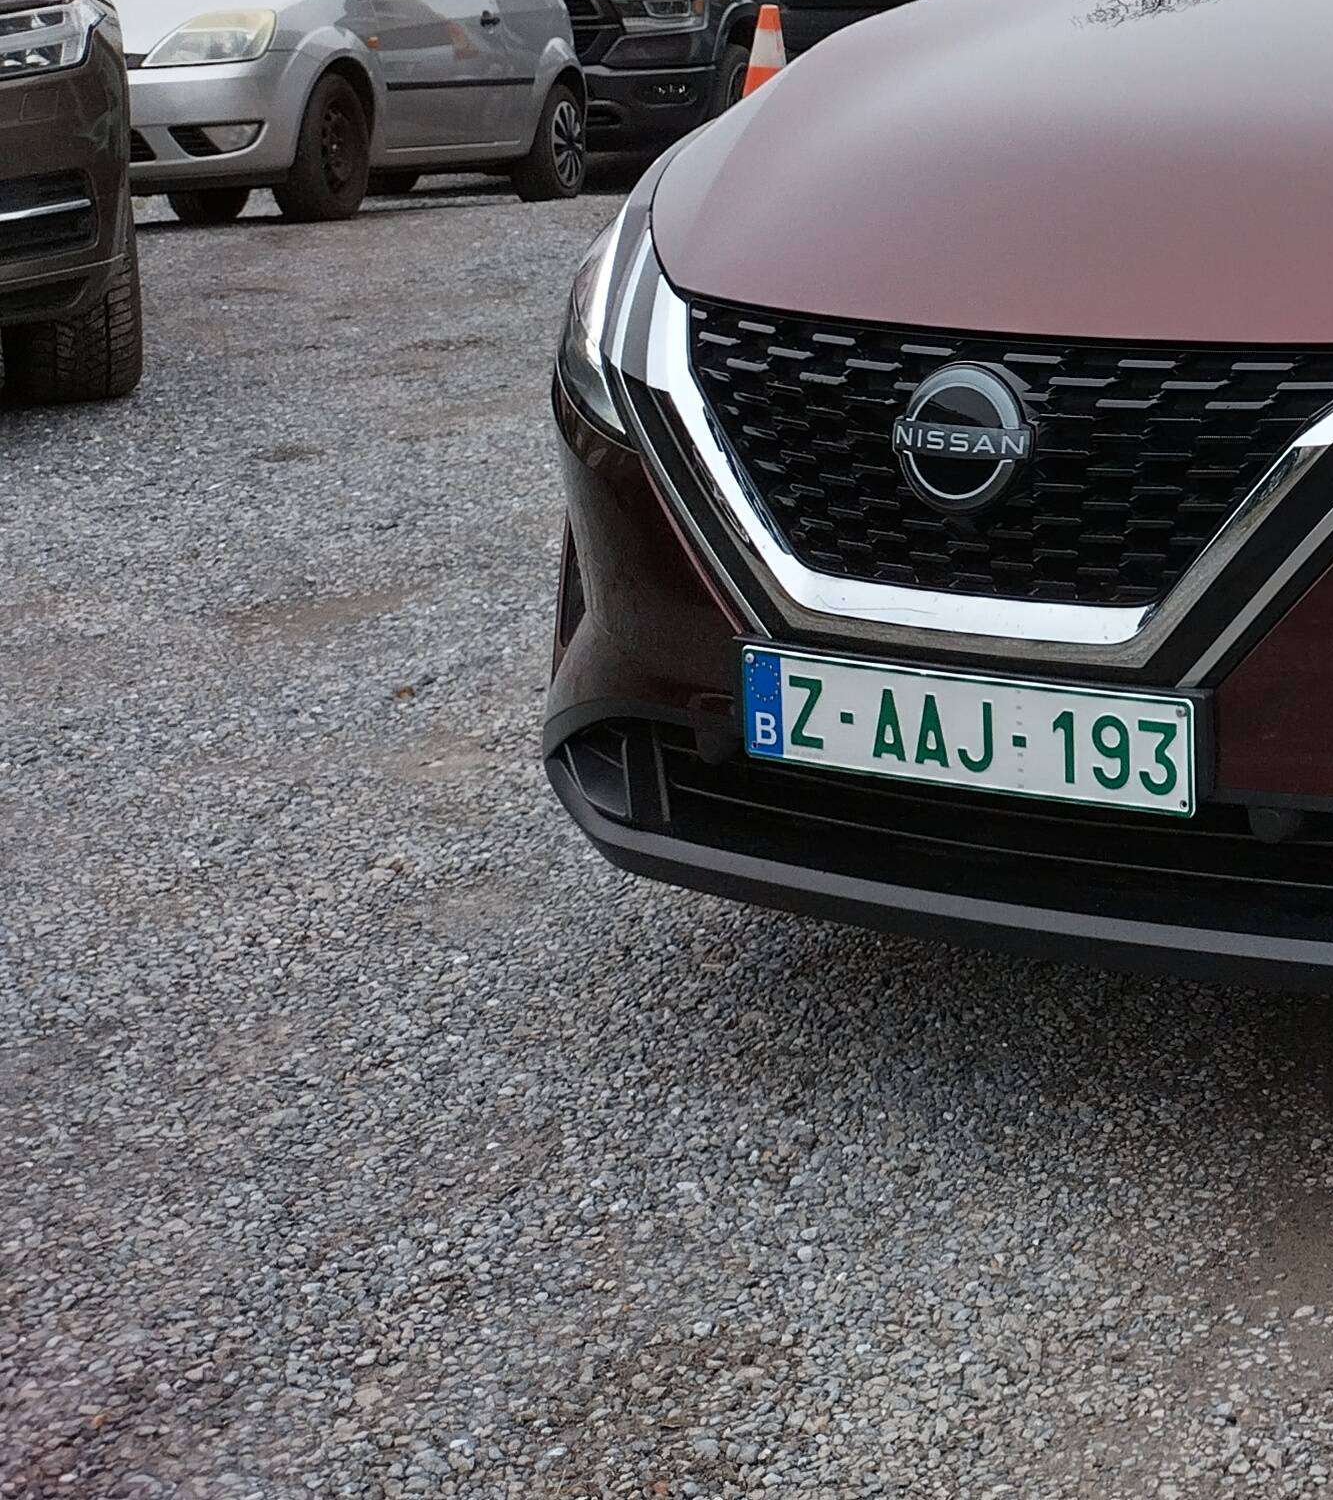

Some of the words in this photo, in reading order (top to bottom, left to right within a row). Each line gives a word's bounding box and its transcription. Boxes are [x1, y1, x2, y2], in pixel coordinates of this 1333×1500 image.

[895, 425, 1025, 455] NISSAN
[755, 711, 778, 746] B
[787, 674, 1179, 796] Z-AAJ-193
